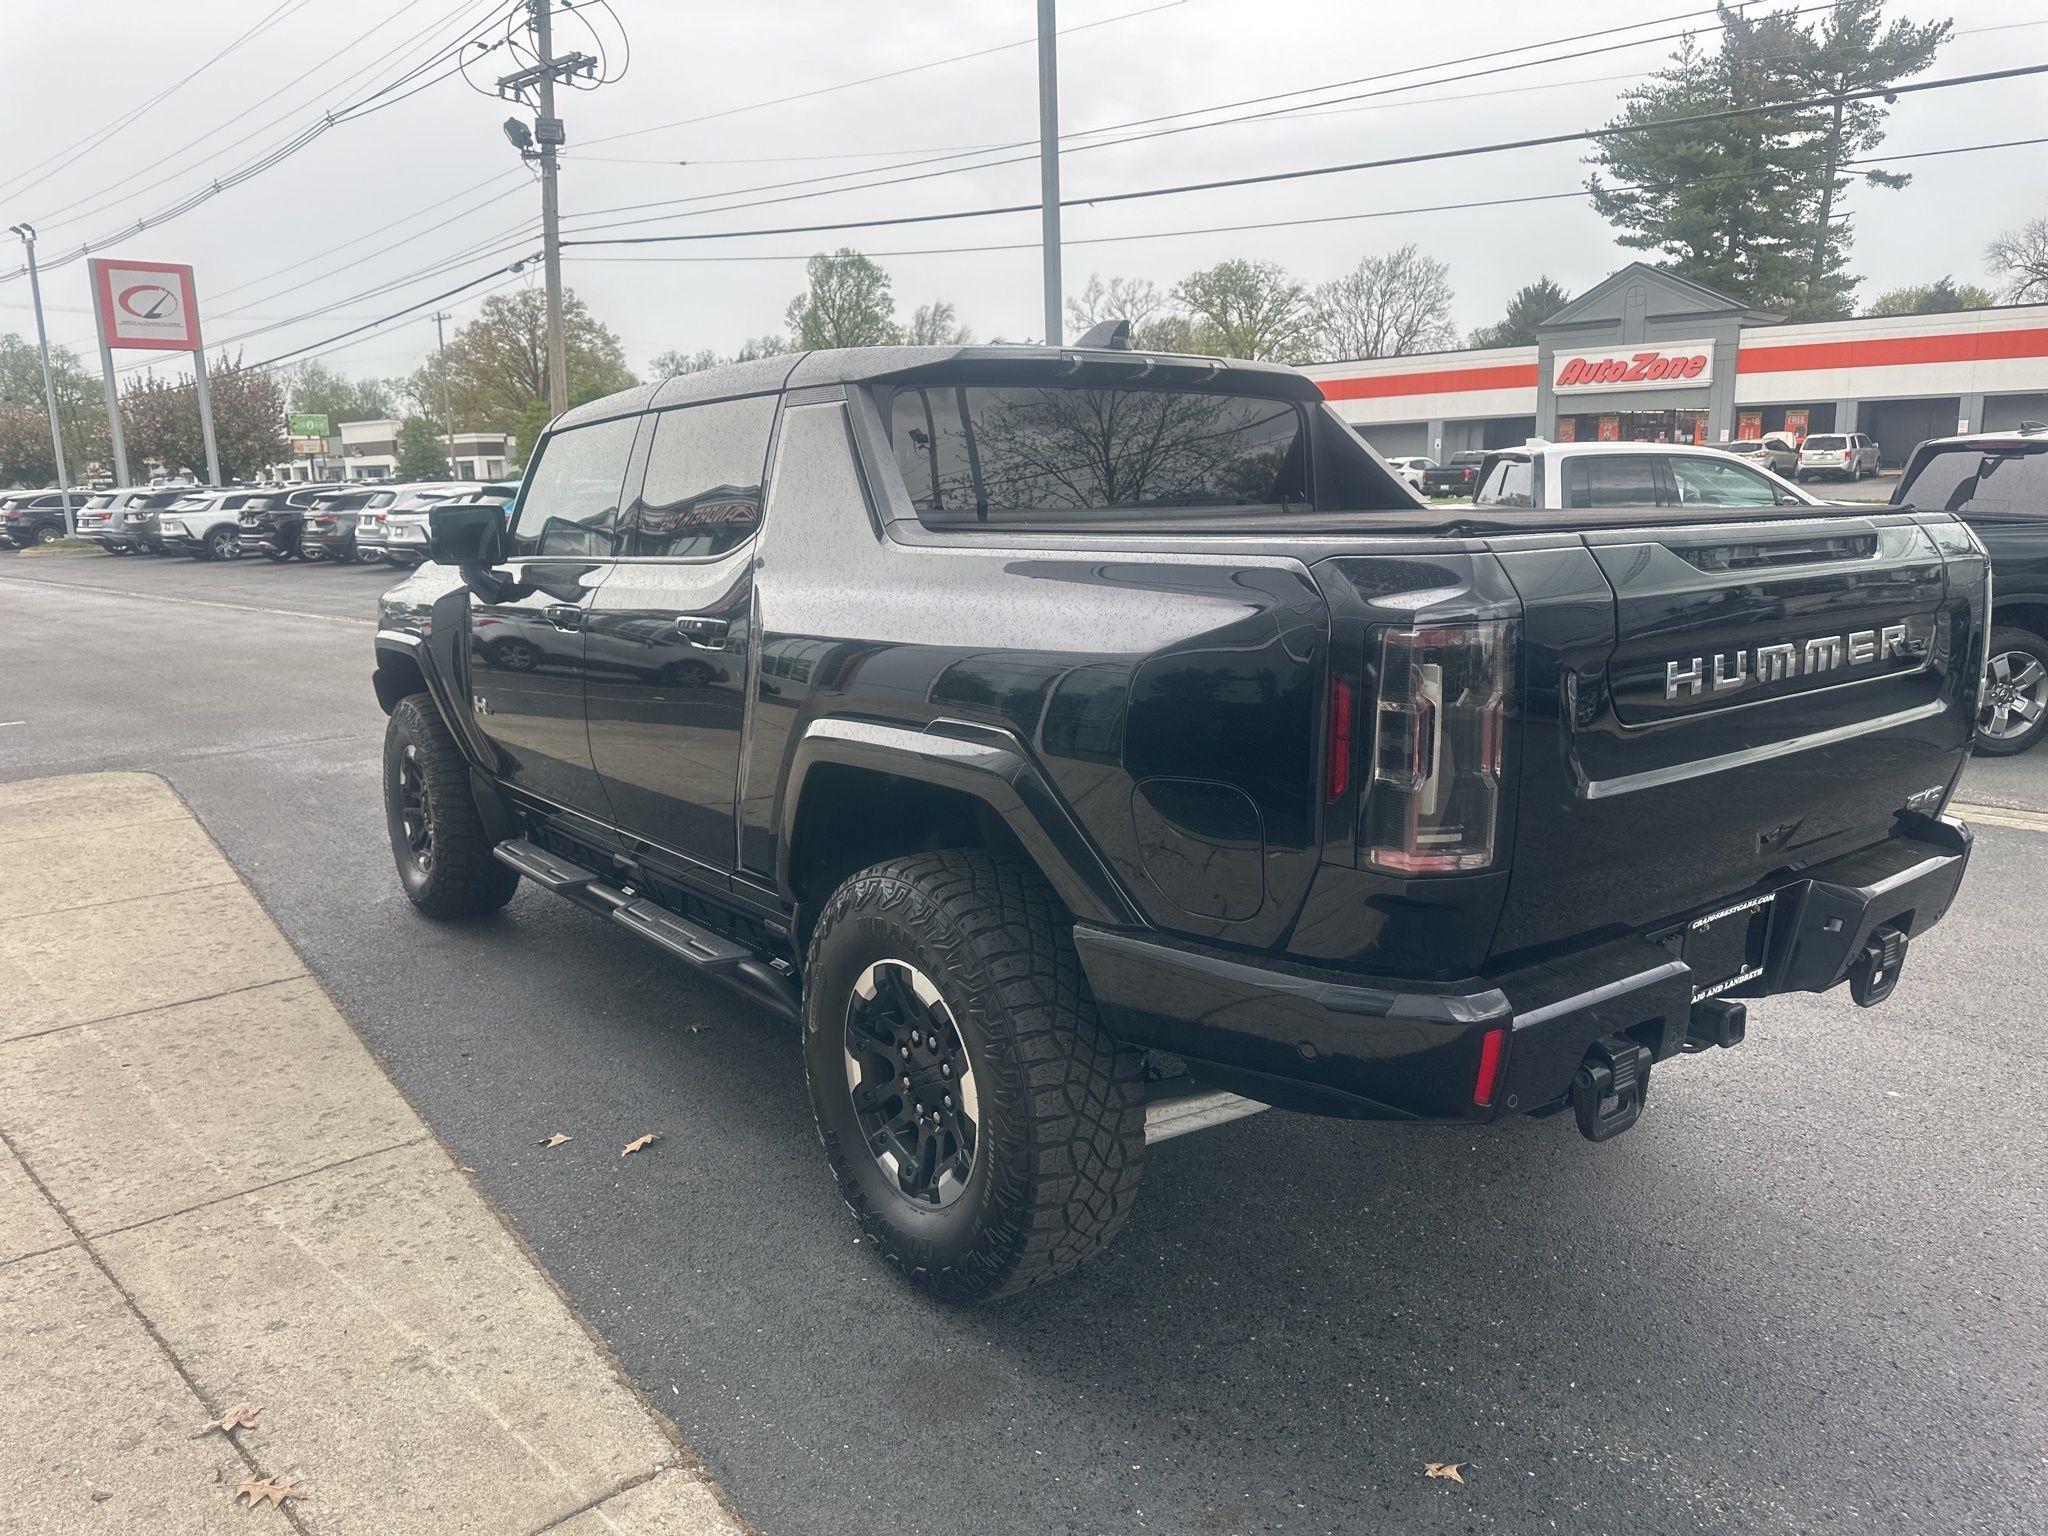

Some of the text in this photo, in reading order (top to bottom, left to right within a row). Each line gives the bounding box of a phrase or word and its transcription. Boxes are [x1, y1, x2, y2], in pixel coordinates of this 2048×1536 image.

[1556, 352, 1708, 386] AutoZone
[1665, 624, 1906, 700] HUMMER
[1691, 967, 1764, 1004] AIG AND LANDRETH
